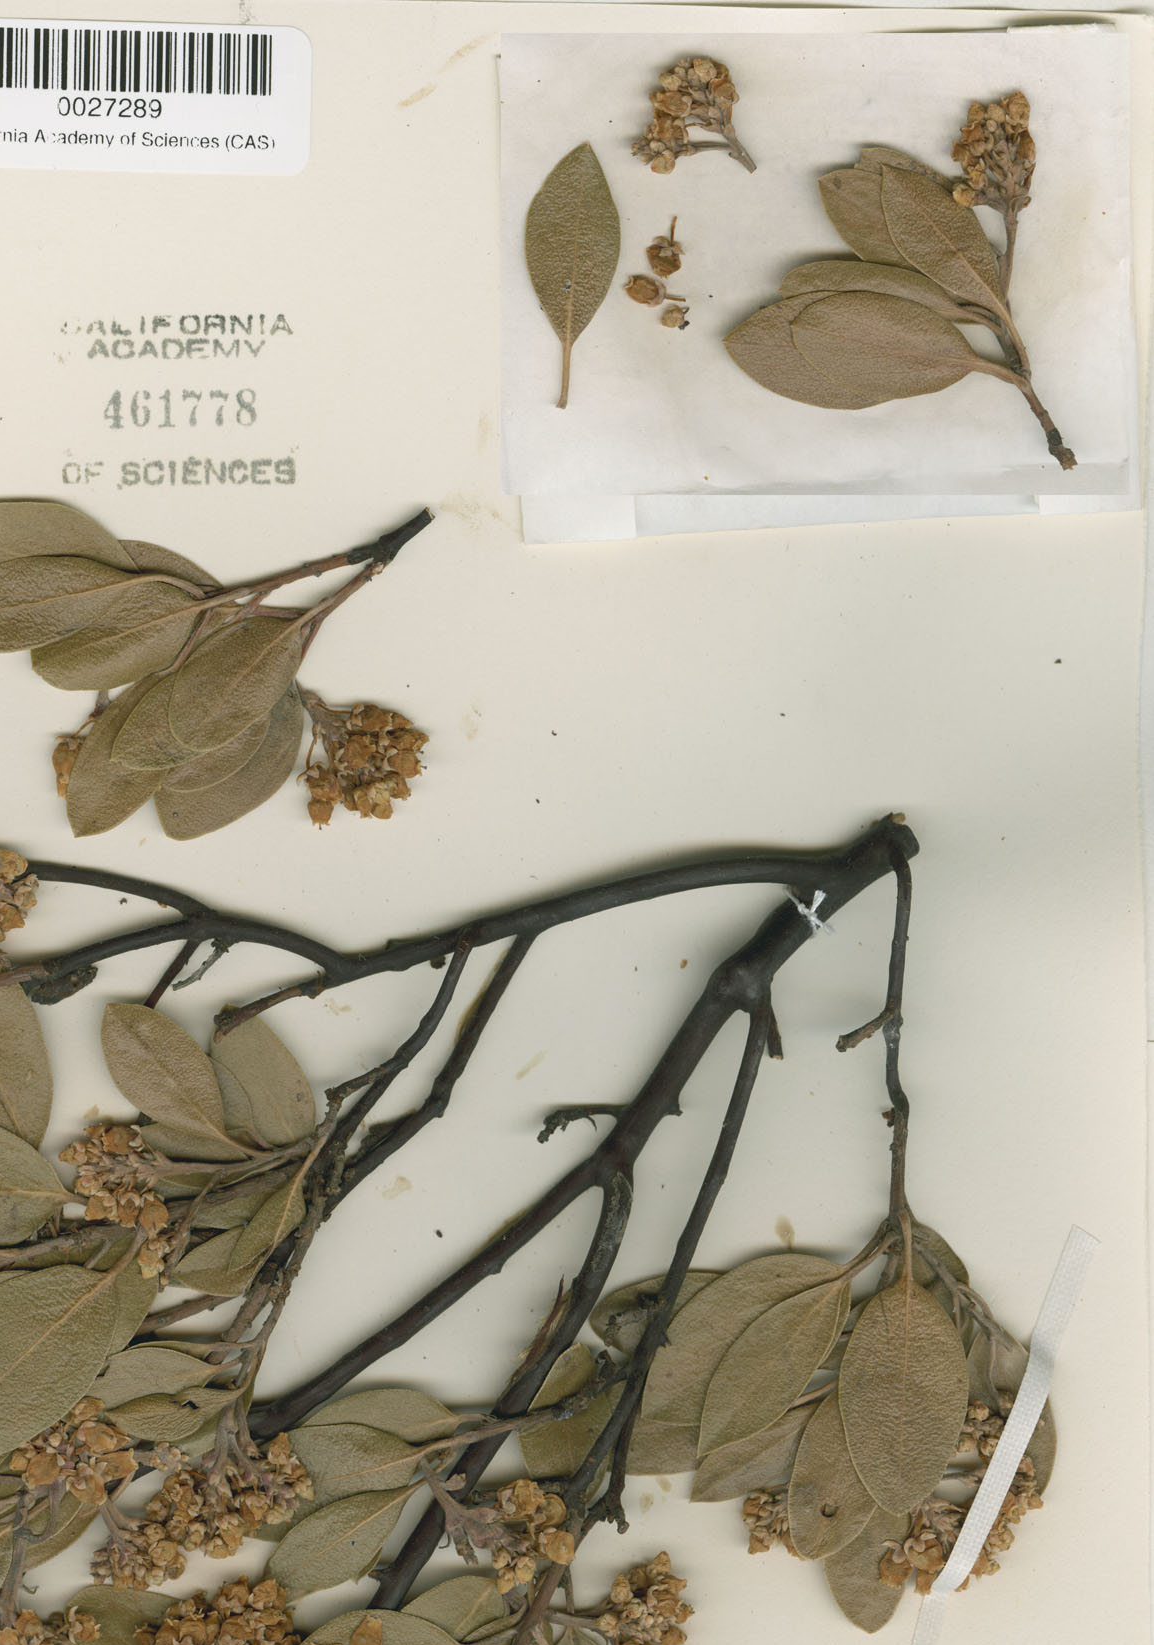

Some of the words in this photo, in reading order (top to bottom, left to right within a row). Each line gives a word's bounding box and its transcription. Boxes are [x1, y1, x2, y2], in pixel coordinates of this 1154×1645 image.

[57, 96, 162, 119] 0027289
[120, 132, 136, 146] of
[142, 132, 220, 148] Sciences
[225, 134, 275, 152] (CAS)
[87, 338, 266, 359] ACADEMY
[103, 388, 258, 429] 461778
[62, 461, 104, 485] OF
[120, 456, 296, 486] SCIENCES
